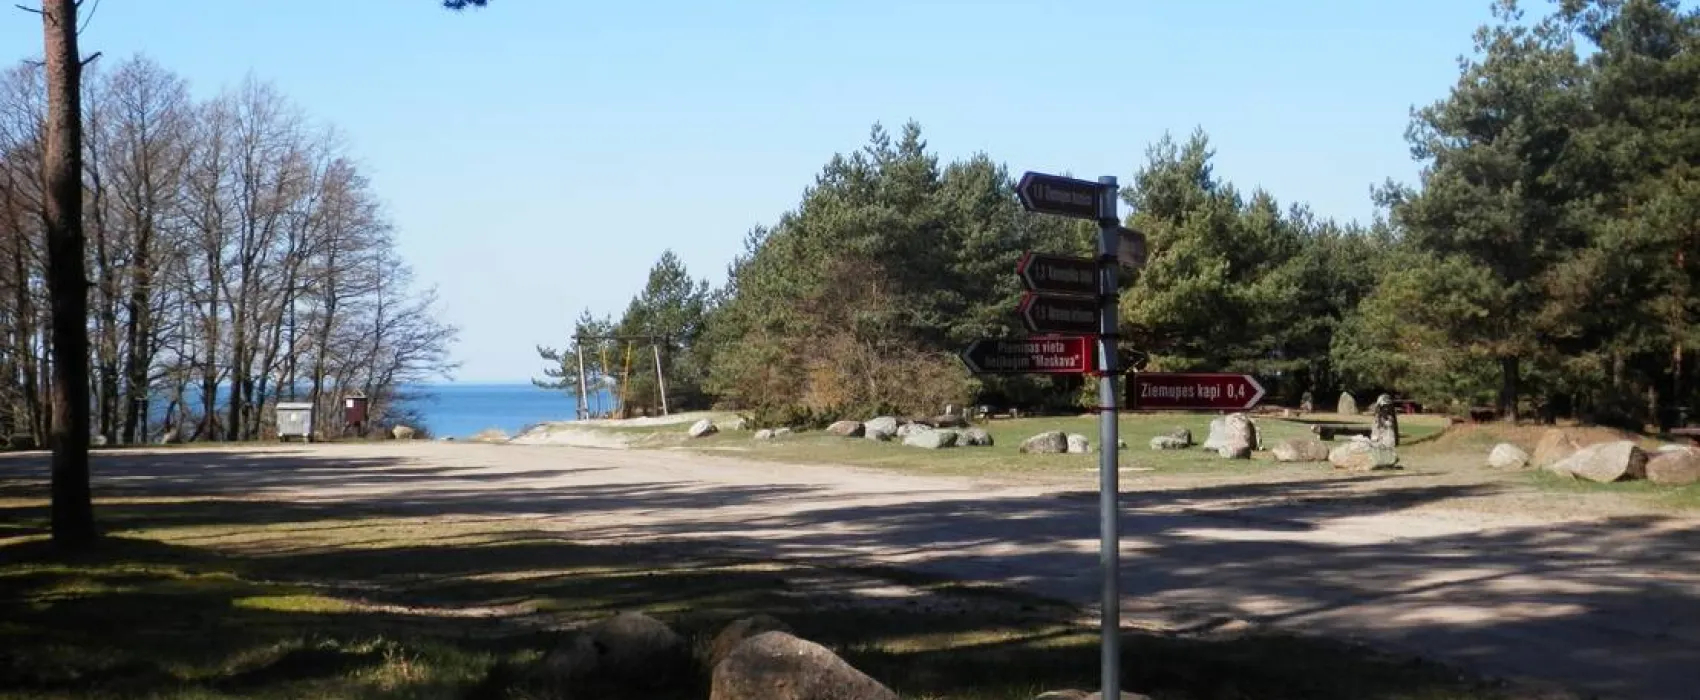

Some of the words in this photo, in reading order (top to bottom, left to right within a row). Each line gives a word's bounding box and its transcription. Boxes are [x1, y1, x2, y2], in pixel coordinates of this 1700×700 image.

[1042, 341, 1065, 354] vieta
[1140, 383, 1194, 402] Ziemupes
[1197, 383, 1220, 401] kapi
[1227, 383, 1245, 401] 0,4
